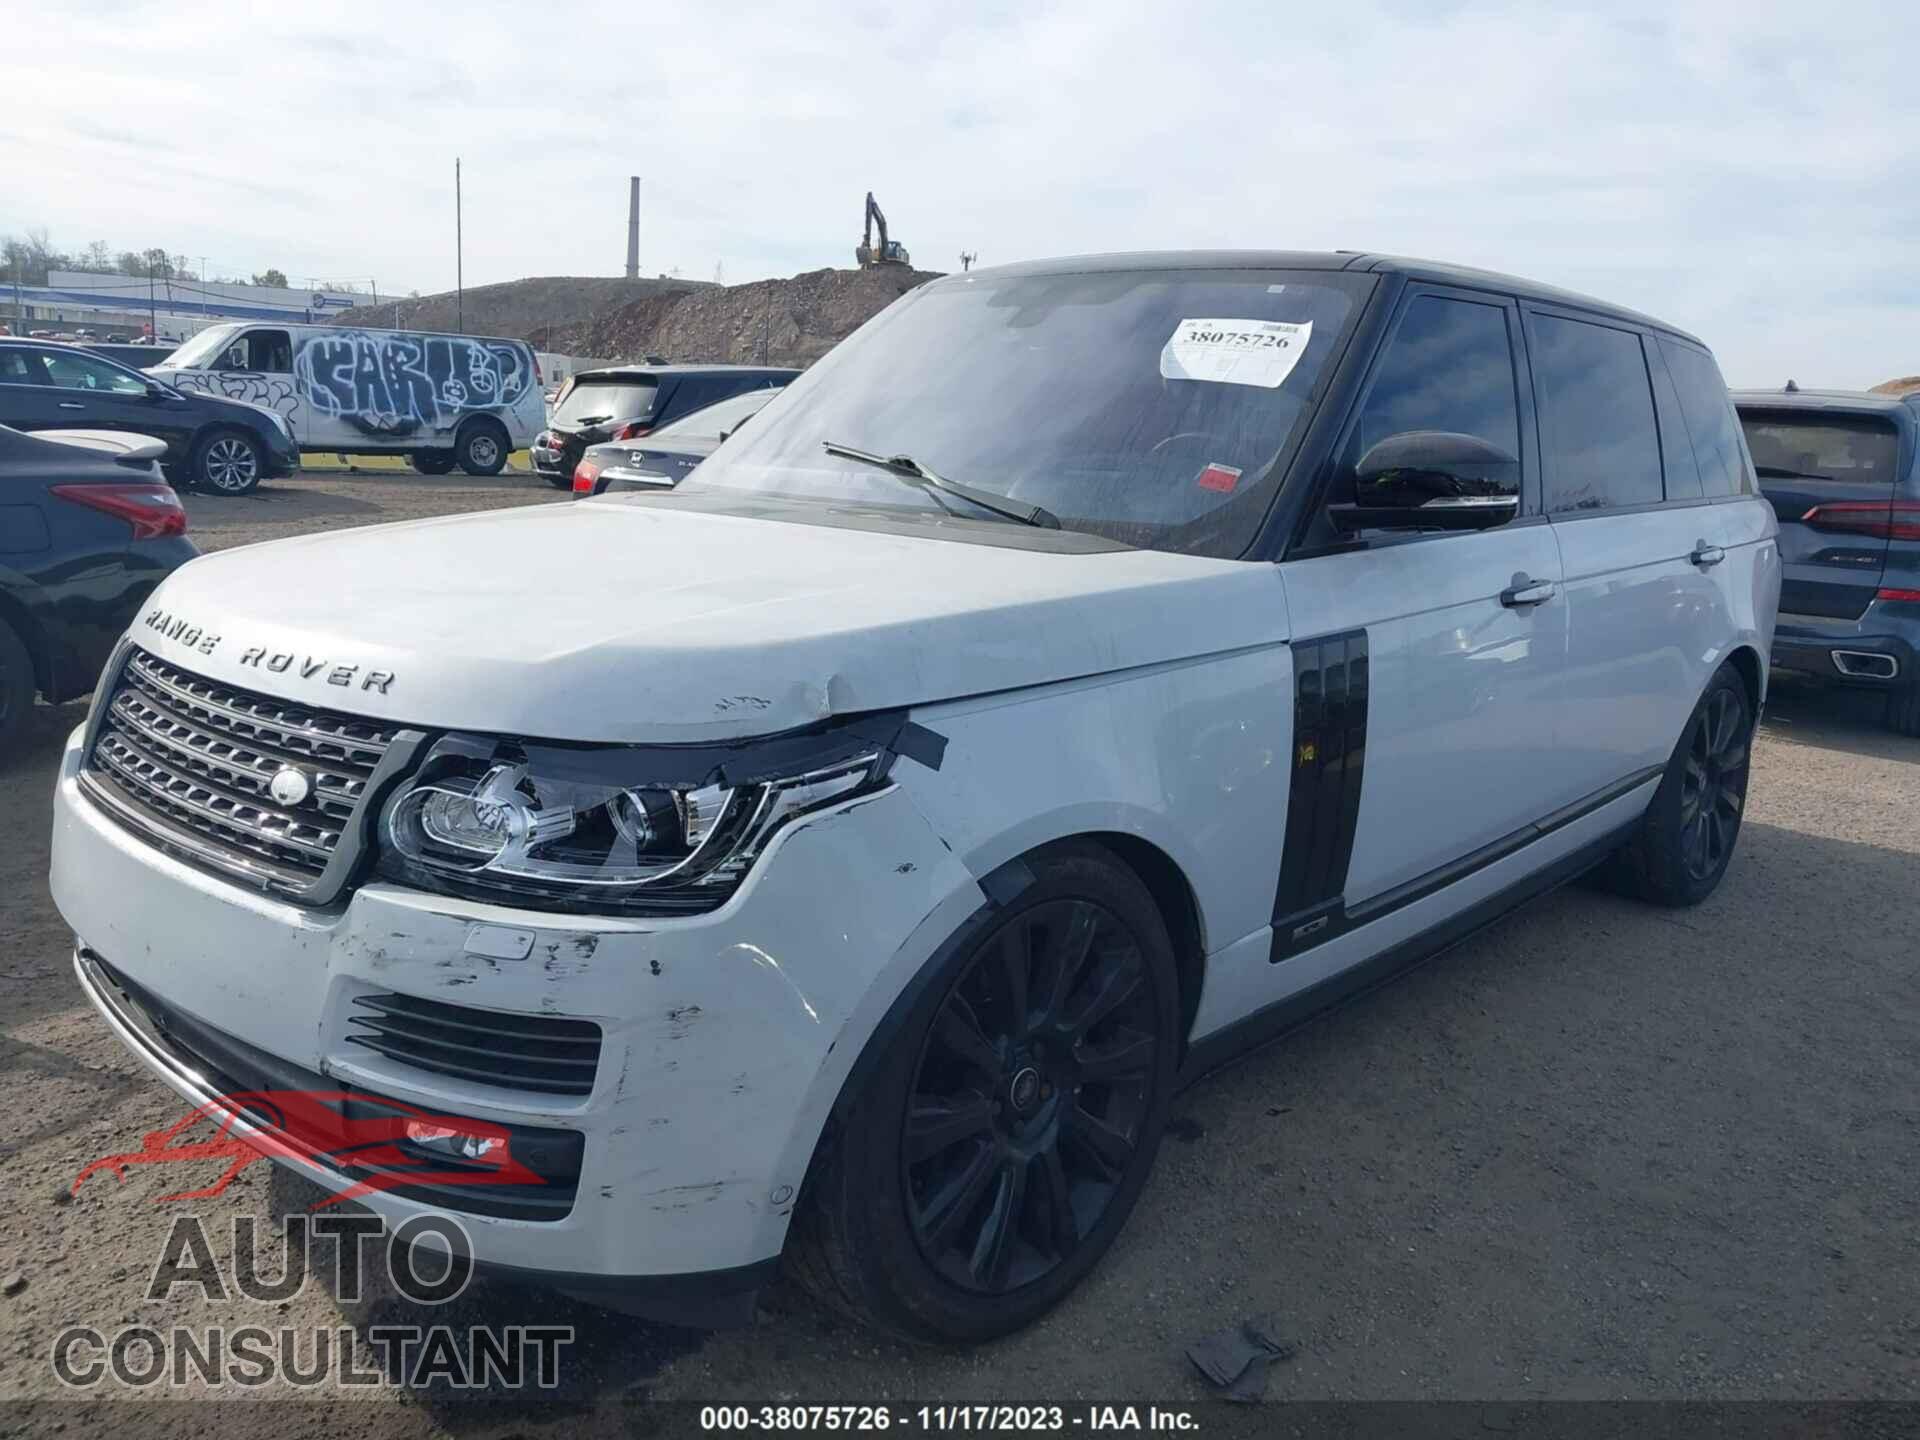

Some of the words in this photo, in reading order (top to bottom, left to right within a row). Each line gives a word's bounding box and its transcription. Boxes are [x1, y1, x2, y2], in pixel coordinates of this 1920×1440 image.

[1184, 331, 1289, 349] 38075726
[145, 610, 222, 655] RANGE
[239, 647, 395, 695] ROVER
